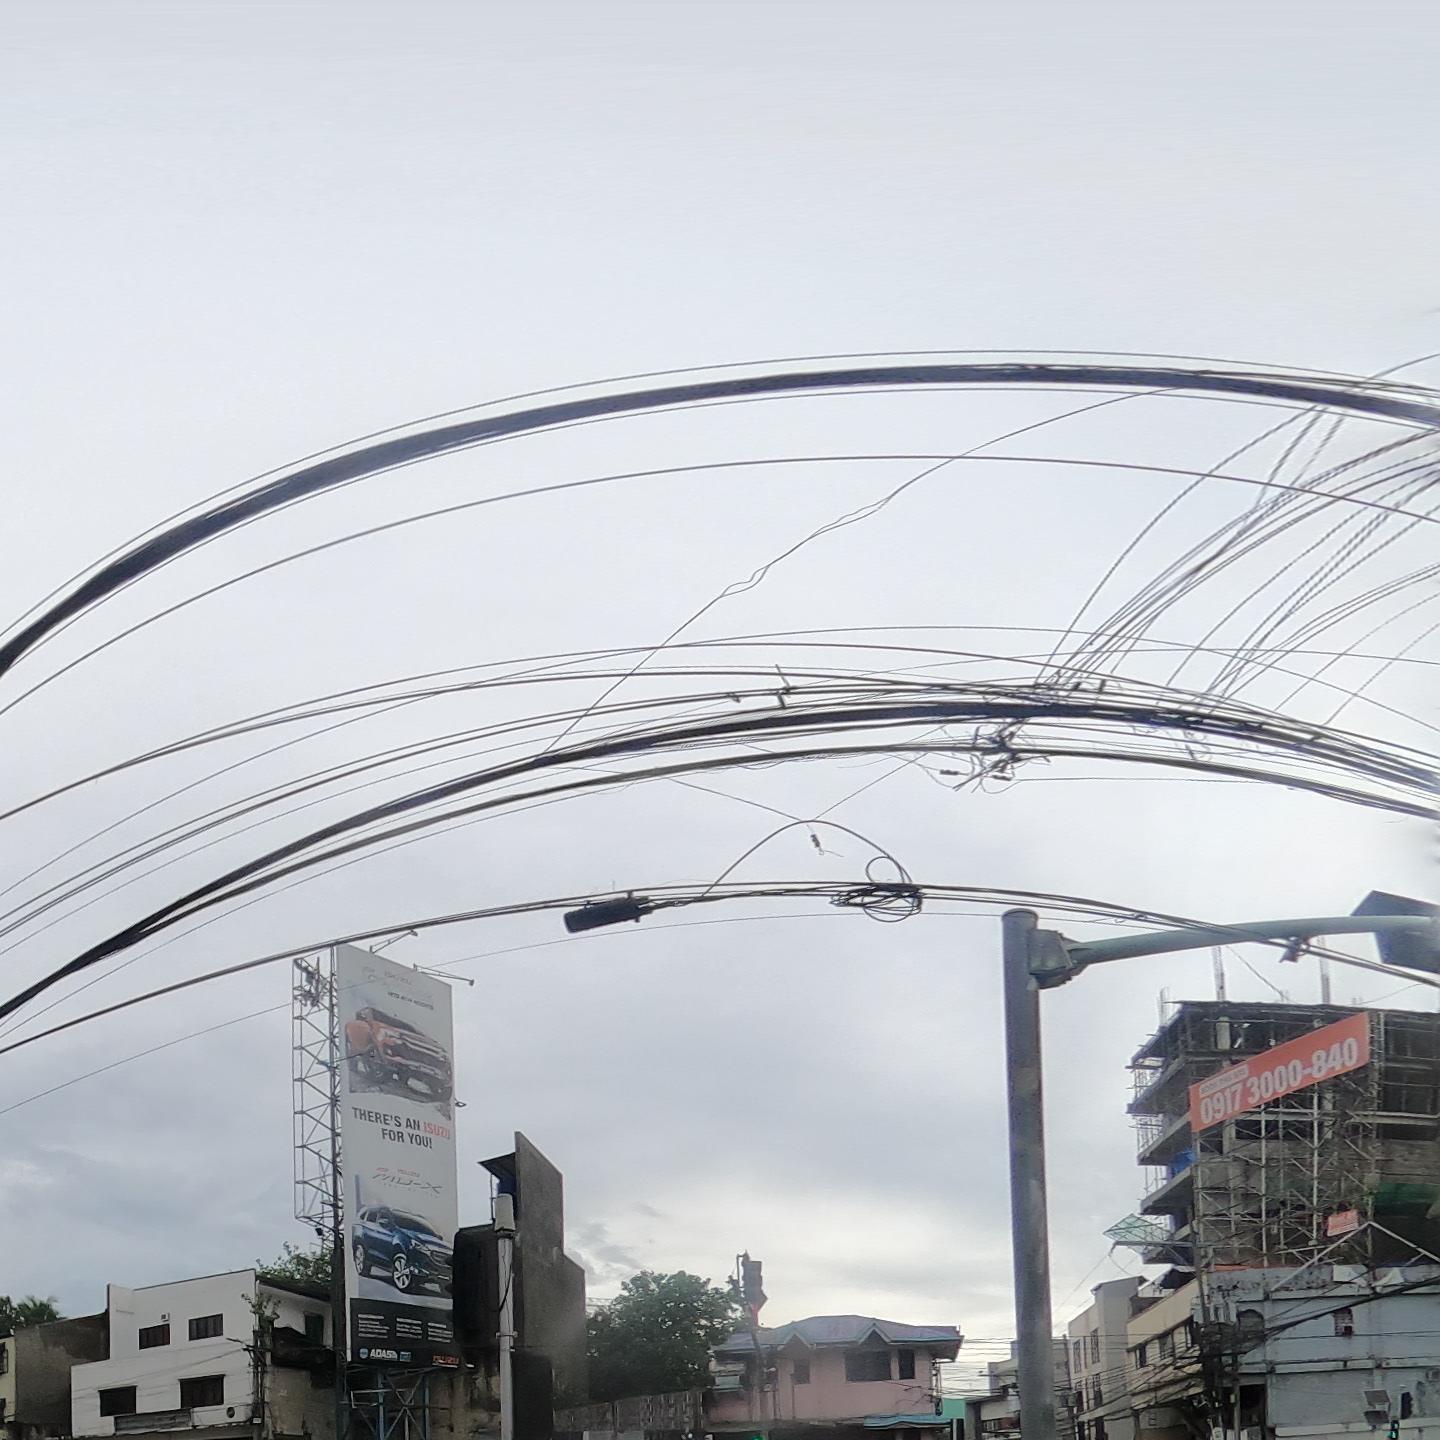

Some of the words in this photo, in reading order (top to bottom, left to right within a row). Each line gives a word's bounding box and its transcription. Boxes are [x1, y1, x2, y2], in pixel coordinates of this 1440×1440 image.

[1200, 1083, 1244, 1124] 0917
[1246, 1037, 1359, 1105] 3000-840
[352, 1106, 402, 1129] THERE'S
[405, 1117, 421, 1131] AN
[423, 1120, 450, 1140] ISUZU
[381, 1127, 405, 1143] FOR
[407, 1132, 433, 1149] YOU!
